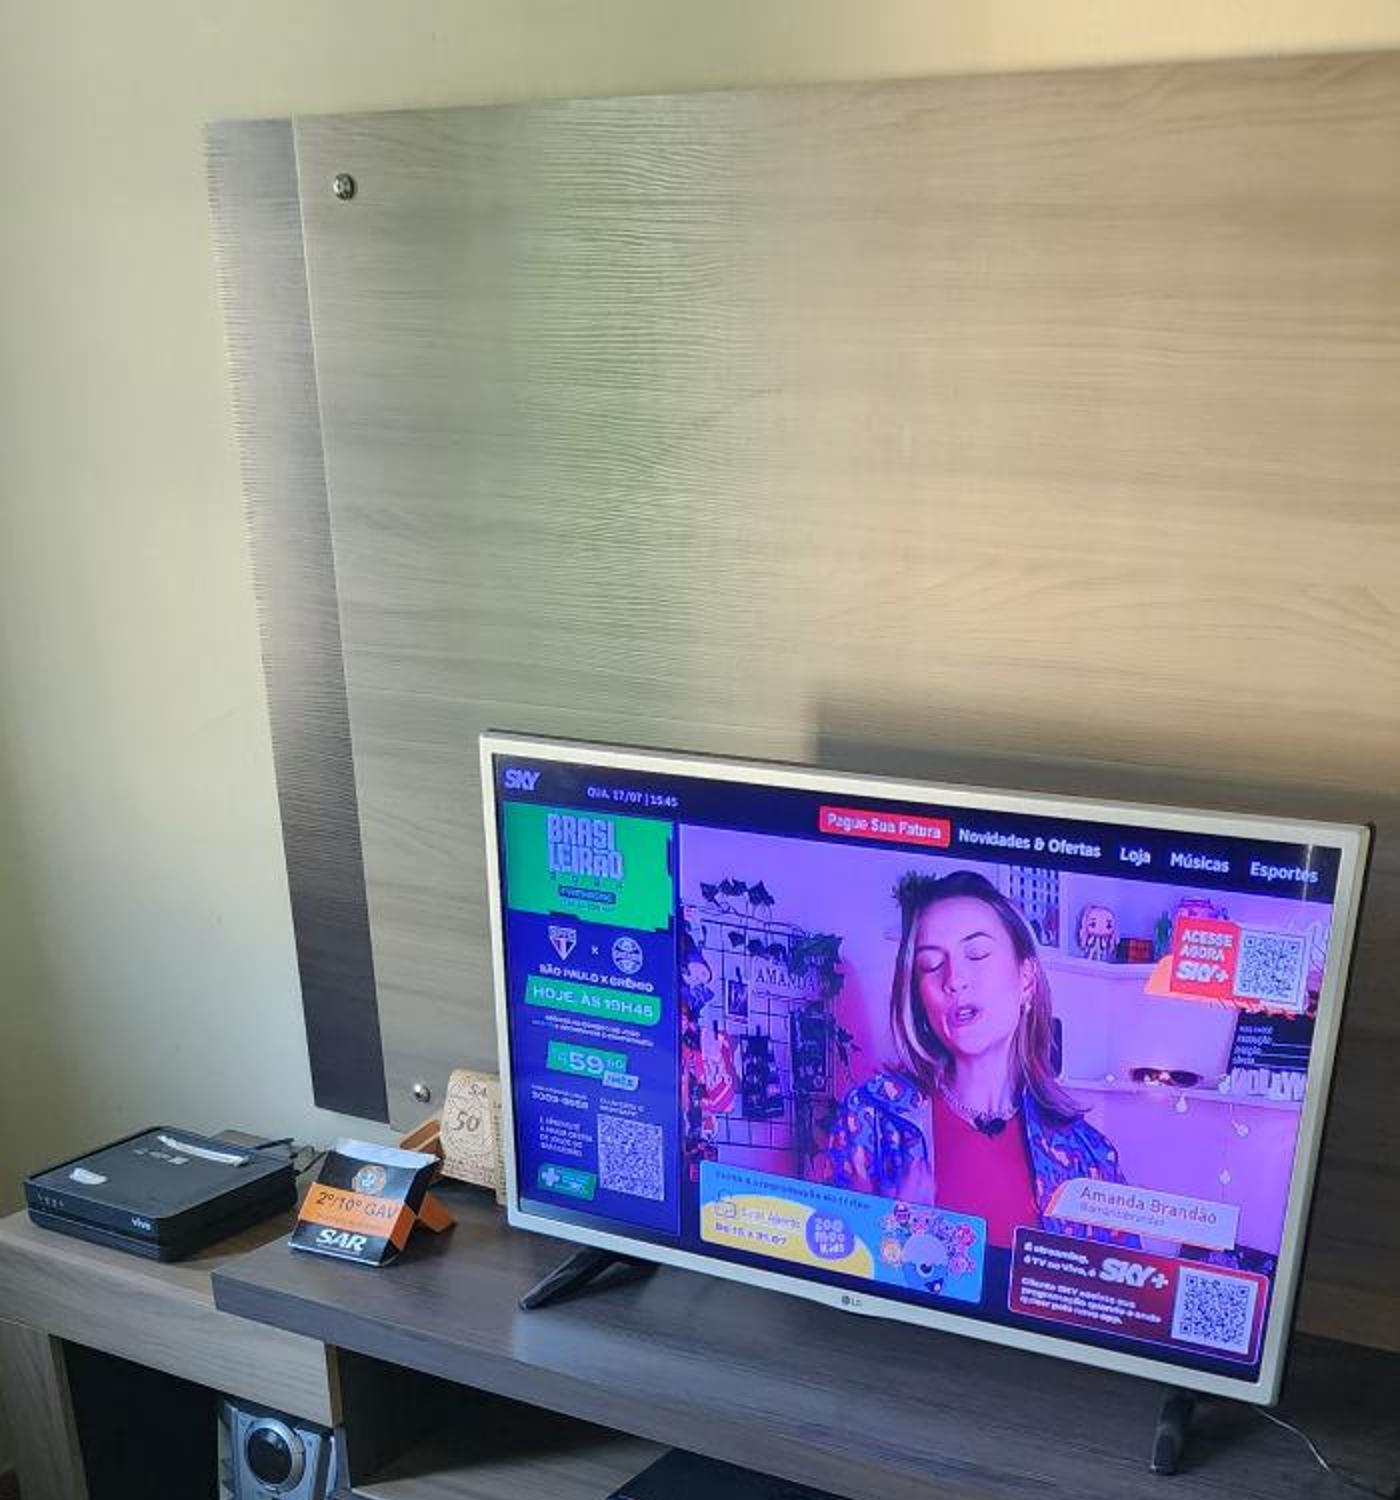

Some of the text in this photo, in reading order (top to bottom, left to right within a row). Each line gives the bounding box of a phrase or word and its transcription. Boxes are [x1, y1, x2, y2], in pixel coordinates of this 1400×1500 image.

[504, 768, 541, 791] SKY
[547, 813, 614, 851] BRASI
[827, 813, 941, 839] Pague Sua Fatura
[959, 829, 1101, 858] Novidades & Ofertas
[1120, 847, 1151, 866] Loja
[1170, 852, 1229, 873] Músicas
[1250, 861, 1318, 883] Esportes
[1181, 929, 1233, 947] ACESSE
[1180, 944, 1225, 961] AGORA
[539, 964, 562, 977] SÃO
[563, 969, 599, 983] PAULO
[609, 976, 654, 993] GRÊMIO
[569, 1051, 604, 1075] 59
[453, 1111, 480, 1133] 50
[1080, 1187, 1217, 1225] Amanda Brandão
[131, 1217, 151, 1231] vivo
[316, 1229, 368, 1251] SAR
[1098, 1257, 1169, 1289] SKY+
